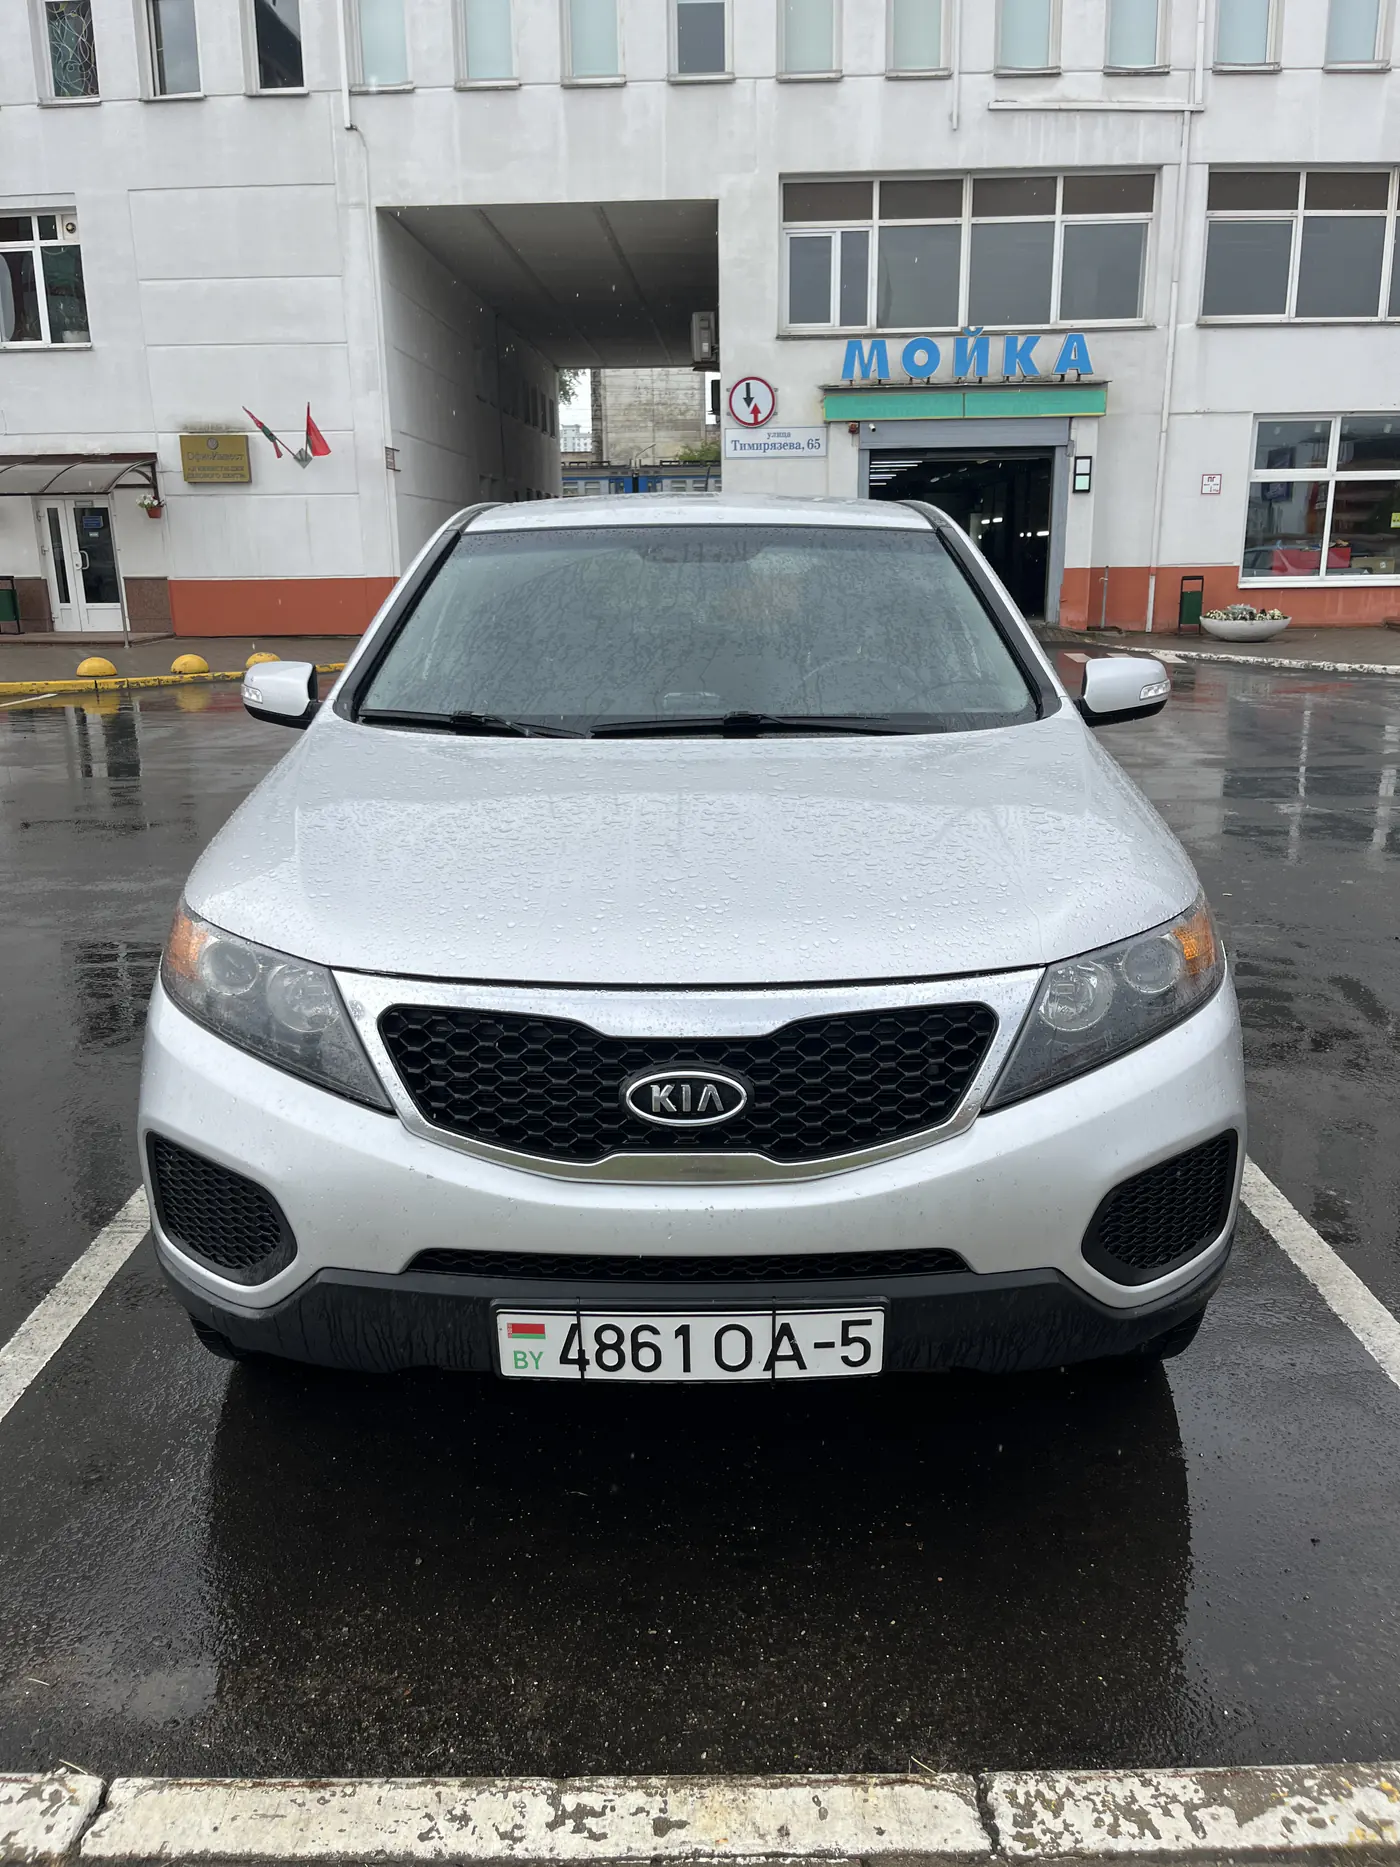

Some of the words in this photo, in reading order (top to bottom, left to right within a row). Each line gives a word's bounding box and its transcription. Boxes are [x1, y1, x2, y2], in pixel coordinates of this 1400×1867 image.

[841, 326, 1094, 380] МОЙКА
[731, 439, 805, 453] Тимирязева,
[806, 438, 821, 450] 65
[766, 431, 791, 440] улица
[650, 1084, 725, 1113] KIA
[513, 1350, 544, 1370] BY
